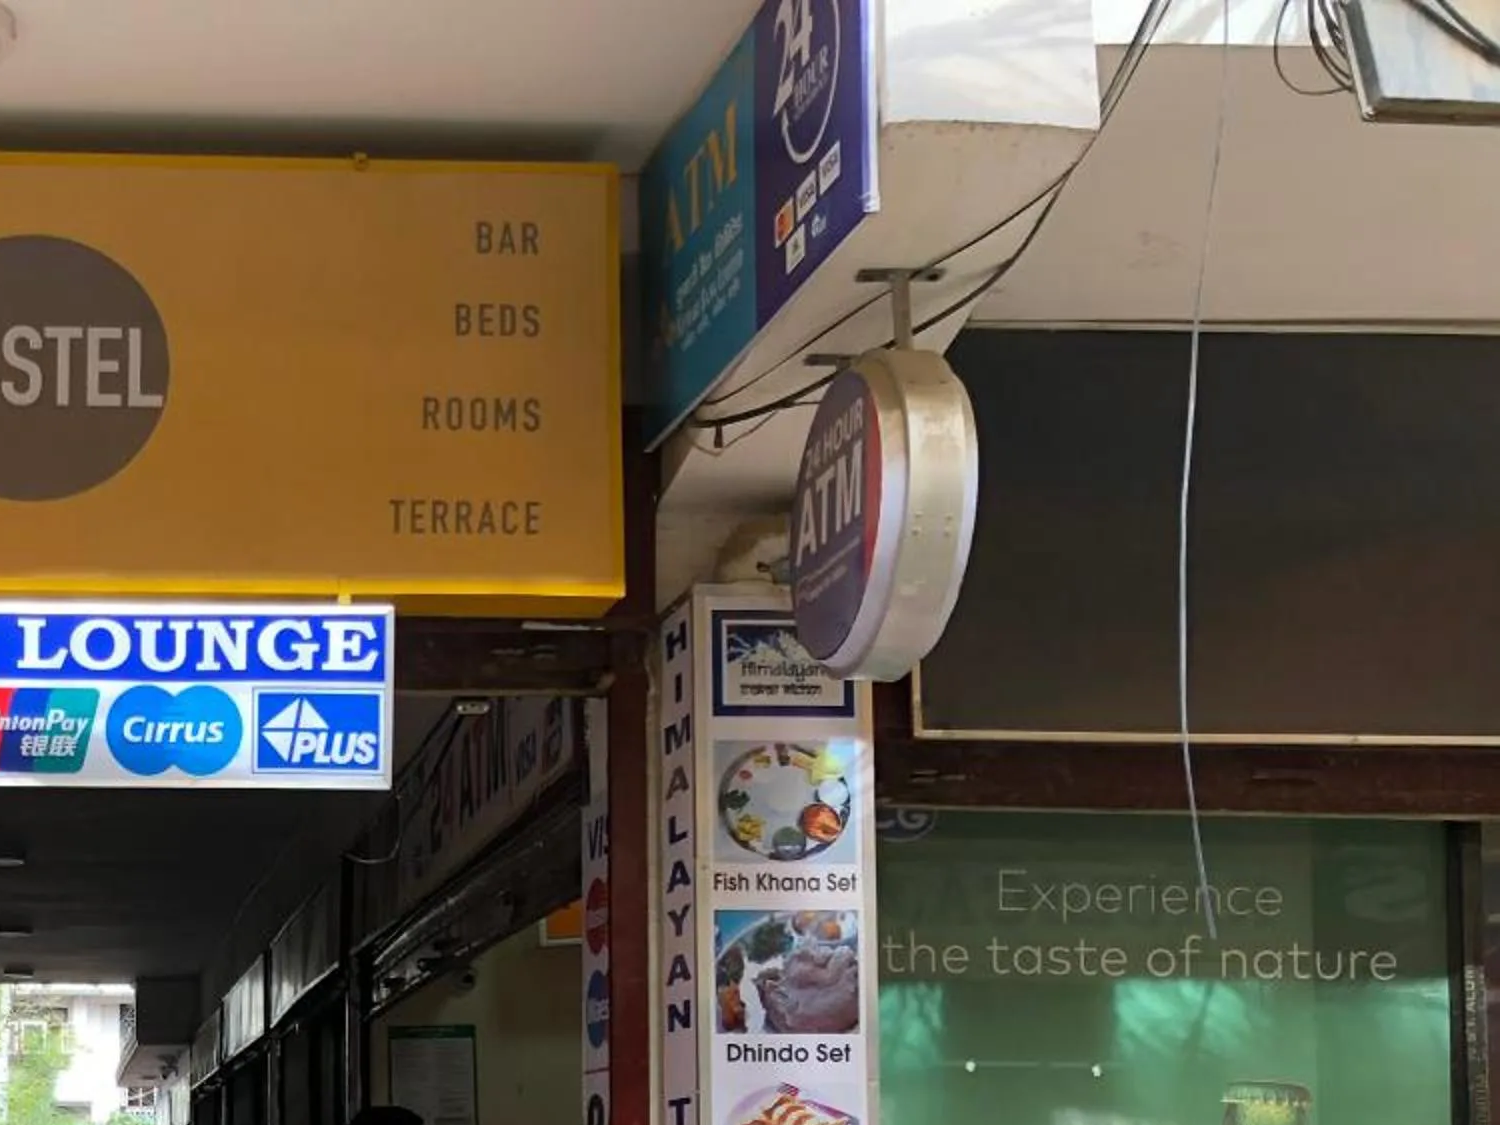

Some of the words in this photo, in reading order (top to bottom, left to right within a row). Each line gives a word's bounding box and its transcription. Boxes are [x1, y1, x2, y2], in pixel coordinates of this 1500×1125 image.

[665, 102, 738, 254] ATM
[476, 221, 540, 255] BAR
[455, 302, 541, 337] BEDS
[422, 397, 542, 432] ROOMS
[824, 397, 864, 456] HOUR
[389, 499, 542, 535] TERRACE
[795, 440, 863, 567] ATM
[17, 618, 379, 672] LOUNGE
[19, 735, 77, 758] 银联
[122, 715, 225, 744] Cirrus
[291, 731, 377, 765] PLUS
[663, 621, 691, 1033] HIMALAYAN
[713, 872, 750, 893] Fish
[756, 872, 821, 893] Khana
[827, 872, 857, 893] Set
[998, 868, 1284, 922] Experience
[883, 929, 970, 975] the
[987, 935, 1128, 978] taste
[1147, 934, 1205, 978] of
[1221, 941, 1398, 981] nature
[726, 1043, 809, 1064] Dhindo
[816, 1042, 852, 1064] Set
